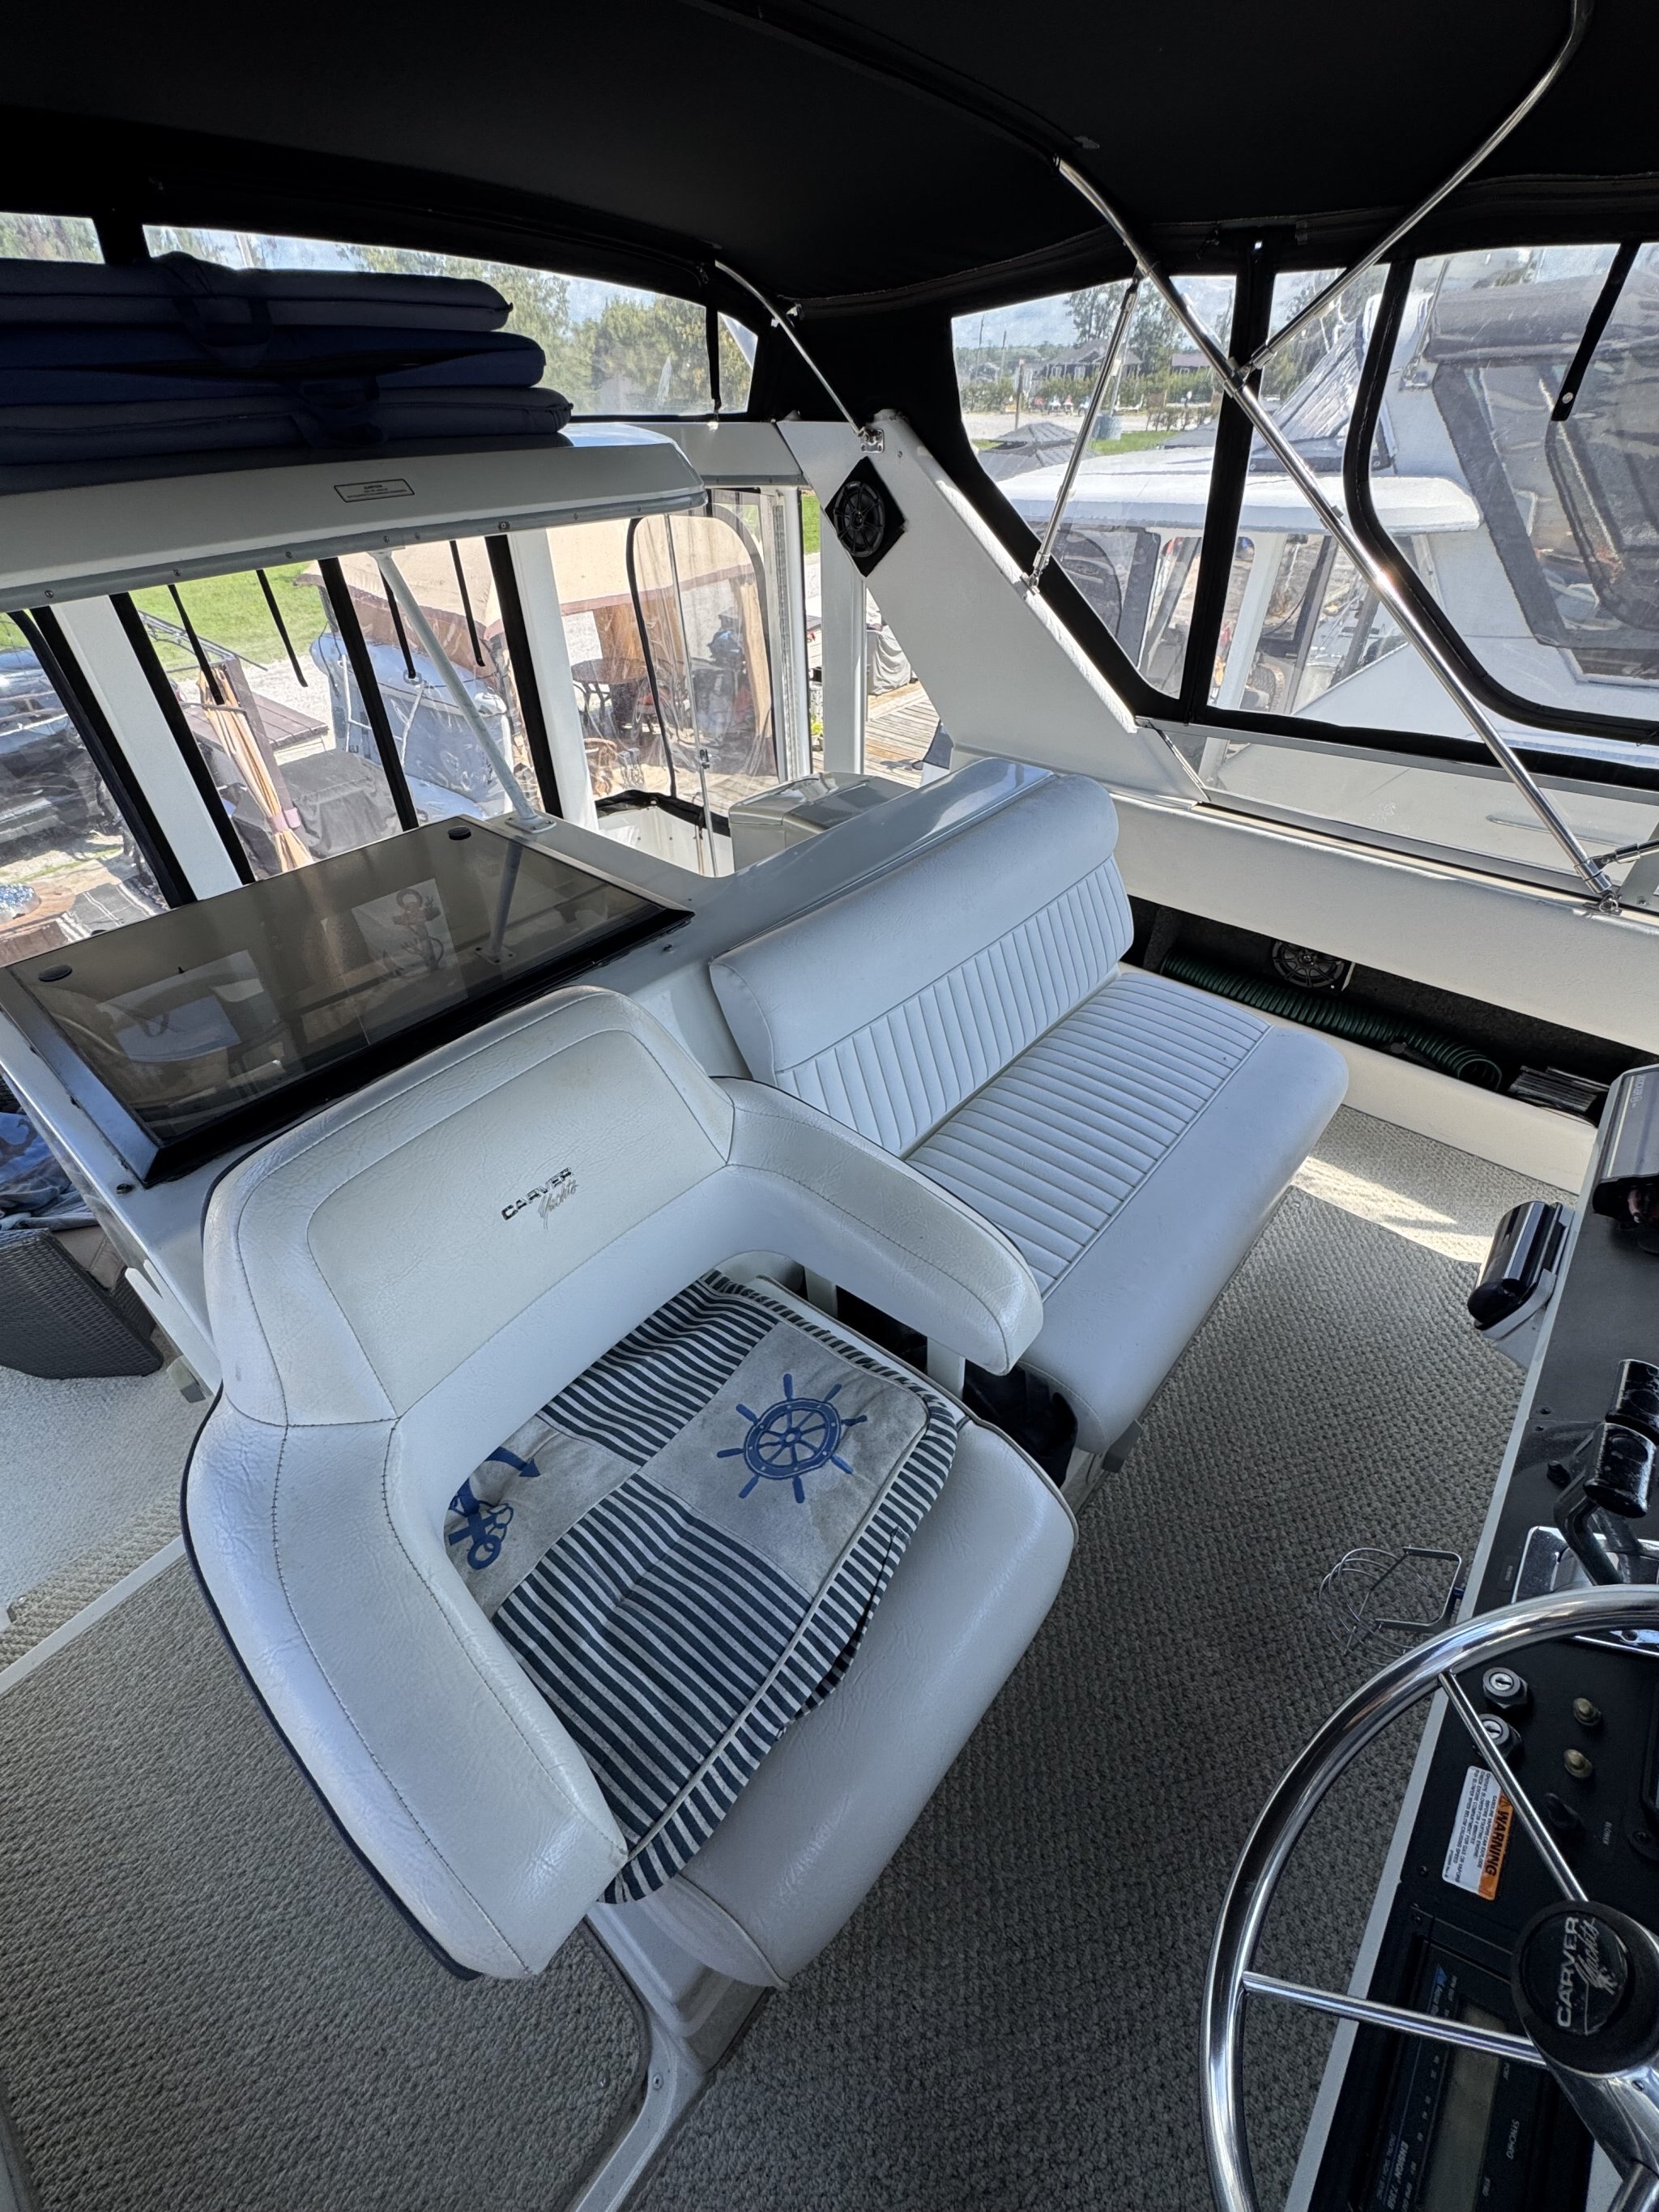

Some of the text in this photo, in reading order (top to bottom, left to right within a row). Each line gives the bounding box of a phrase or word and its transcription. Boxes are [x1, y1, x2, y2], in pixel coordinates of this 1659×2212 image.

[501, 1167, 574, 1221] CARVER
[1485, 1810, 1509, 1876] WARNING
[1557, 1916, 1580, 2027] CARVER
